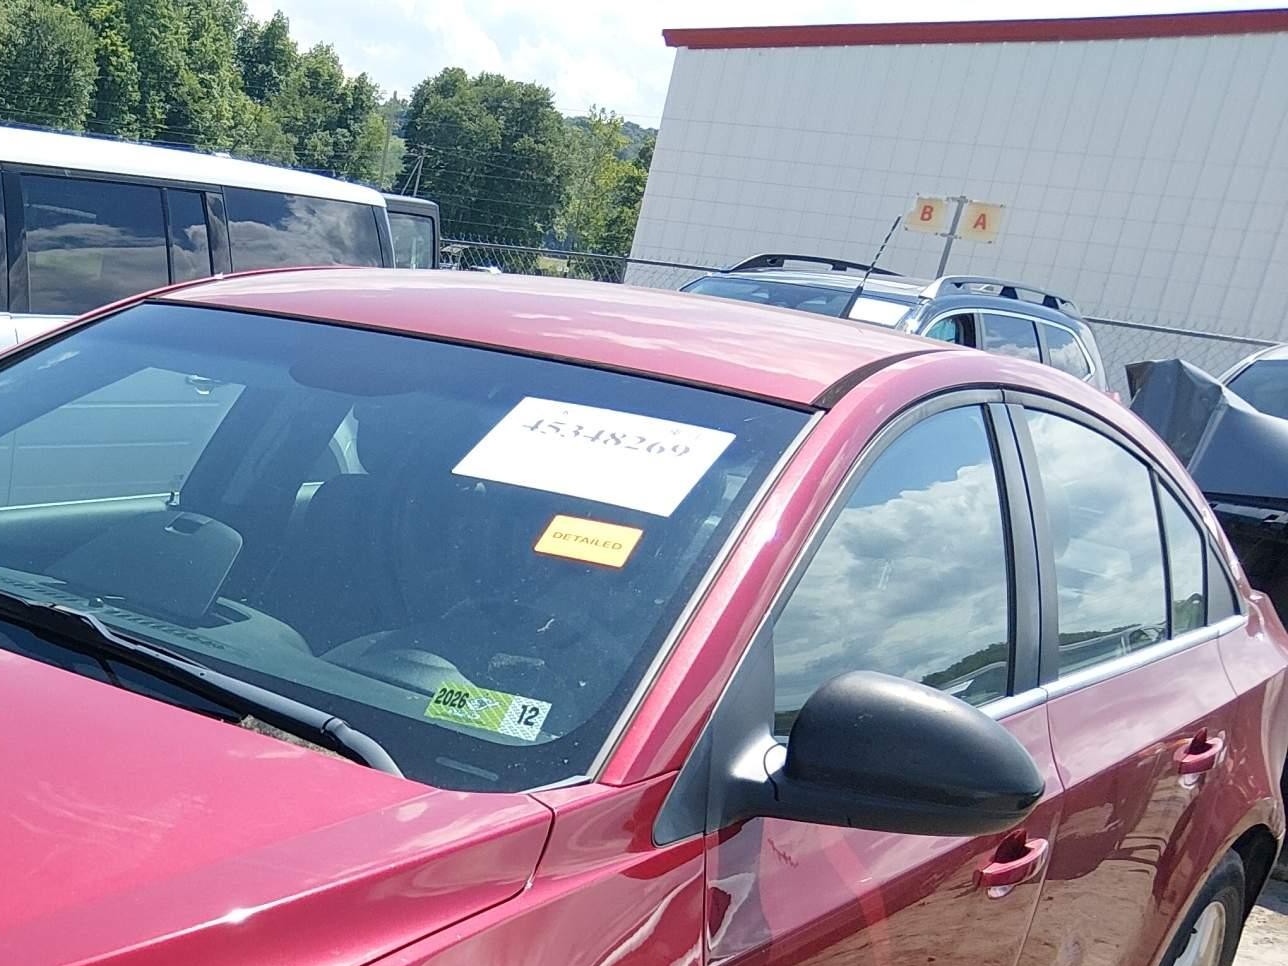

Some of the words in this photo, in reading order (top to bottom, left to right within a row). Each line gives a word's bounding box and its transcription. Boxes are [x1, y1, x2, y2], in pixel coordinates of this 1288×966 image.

[920, 205, 934, 222] B
[972, 212, 987, 231] A
[521, 417, 690, 457] 45348269
[551, 530, 623, 552] DETAILED
[433, 687, 470, 709] 2026
[517, 704, 540, 726] 12
